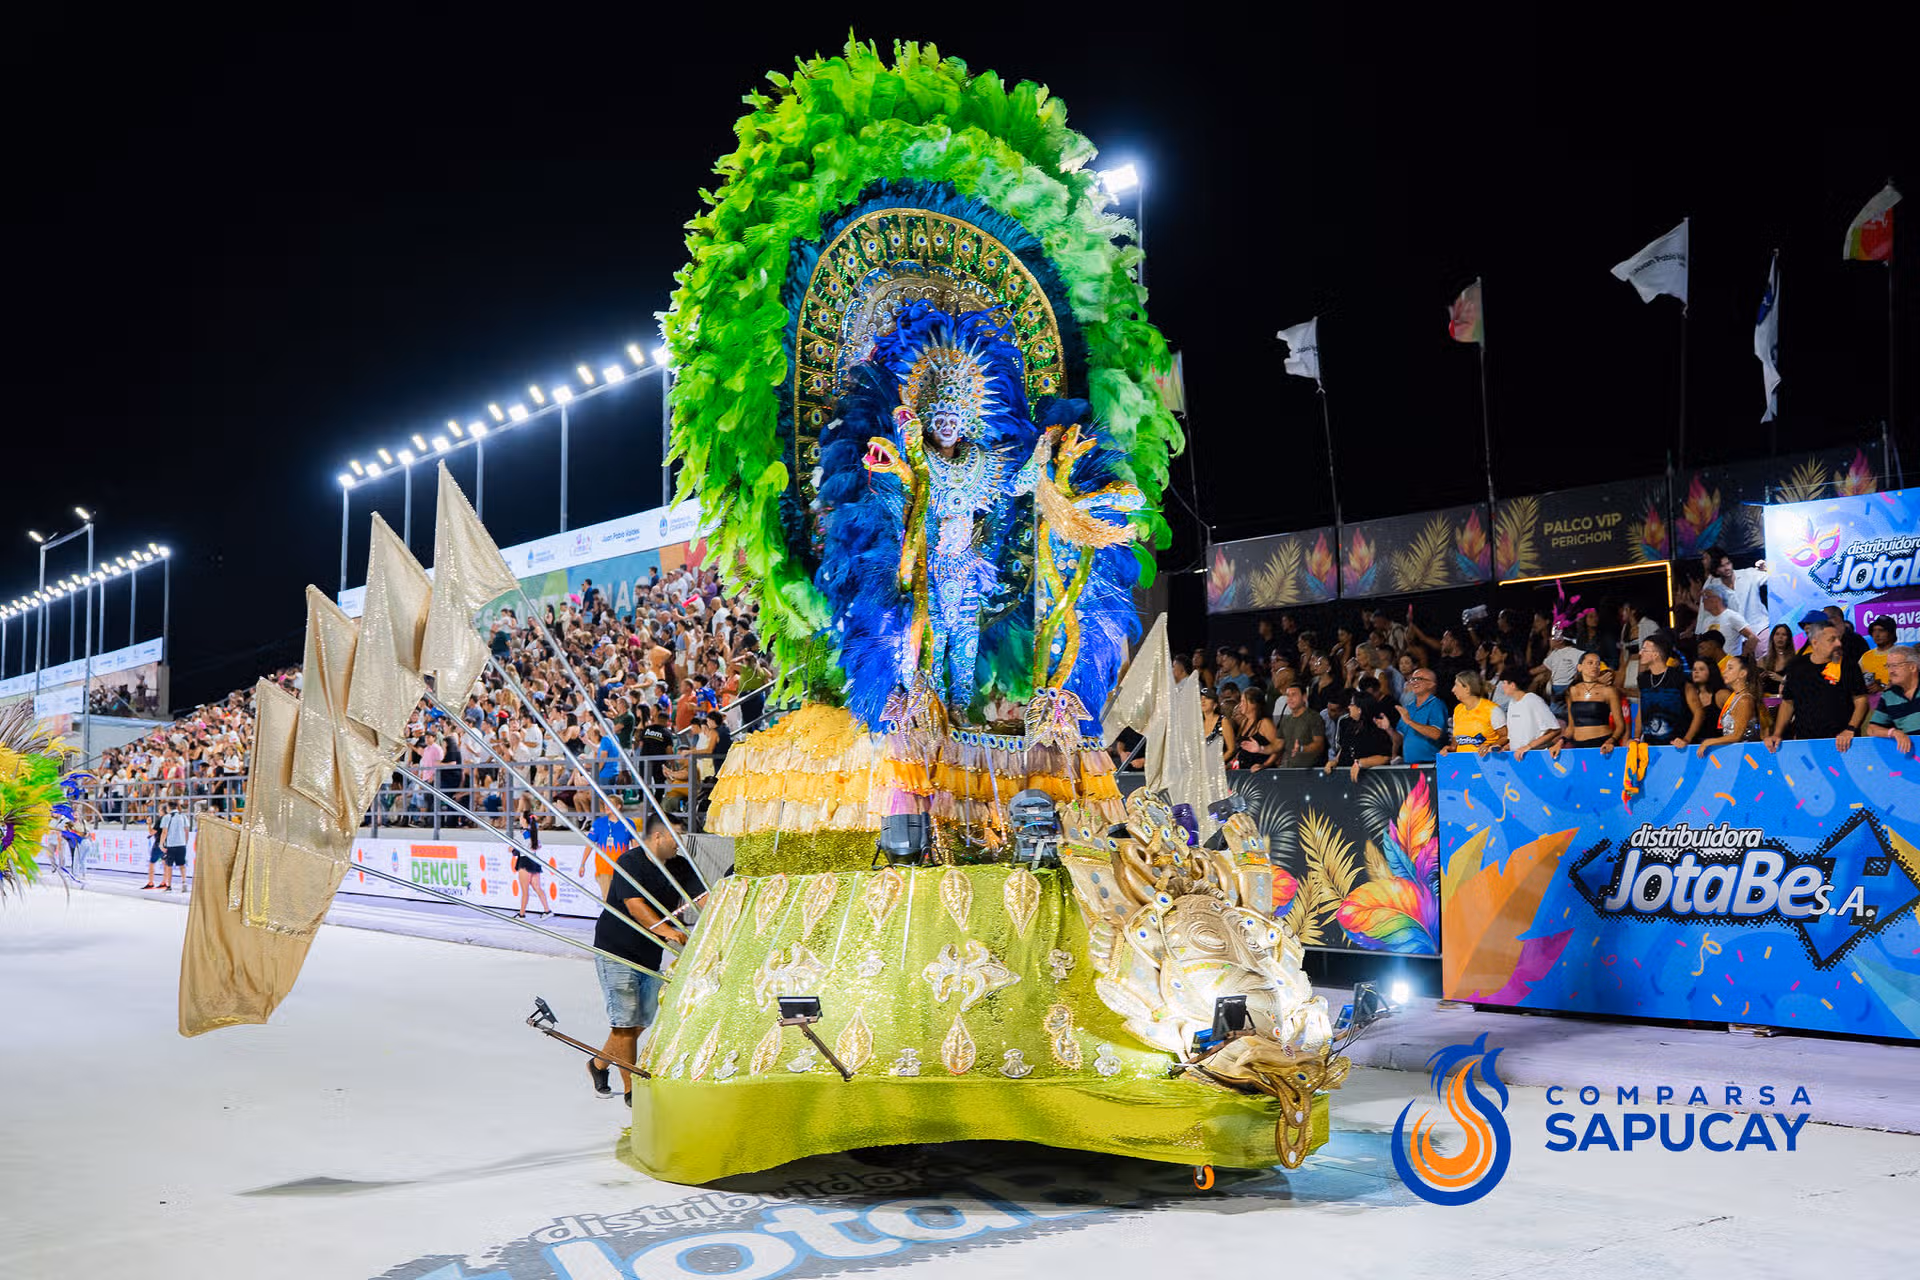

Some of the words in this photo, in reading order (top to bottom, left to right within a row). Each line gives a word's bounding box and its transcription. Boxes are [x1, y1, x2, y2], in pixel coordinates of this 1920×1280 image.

[1543, 517, 1593, 536] PALCO
[1595, 512, 1622, 528] VIP
[1551, 530, 1612, 548] PERICHON
[1630, 823, 1763, 848] distribuidora
[411, 861, 468, 887] DENGUE
[1605, 849, 1823, 916] JotaBe
